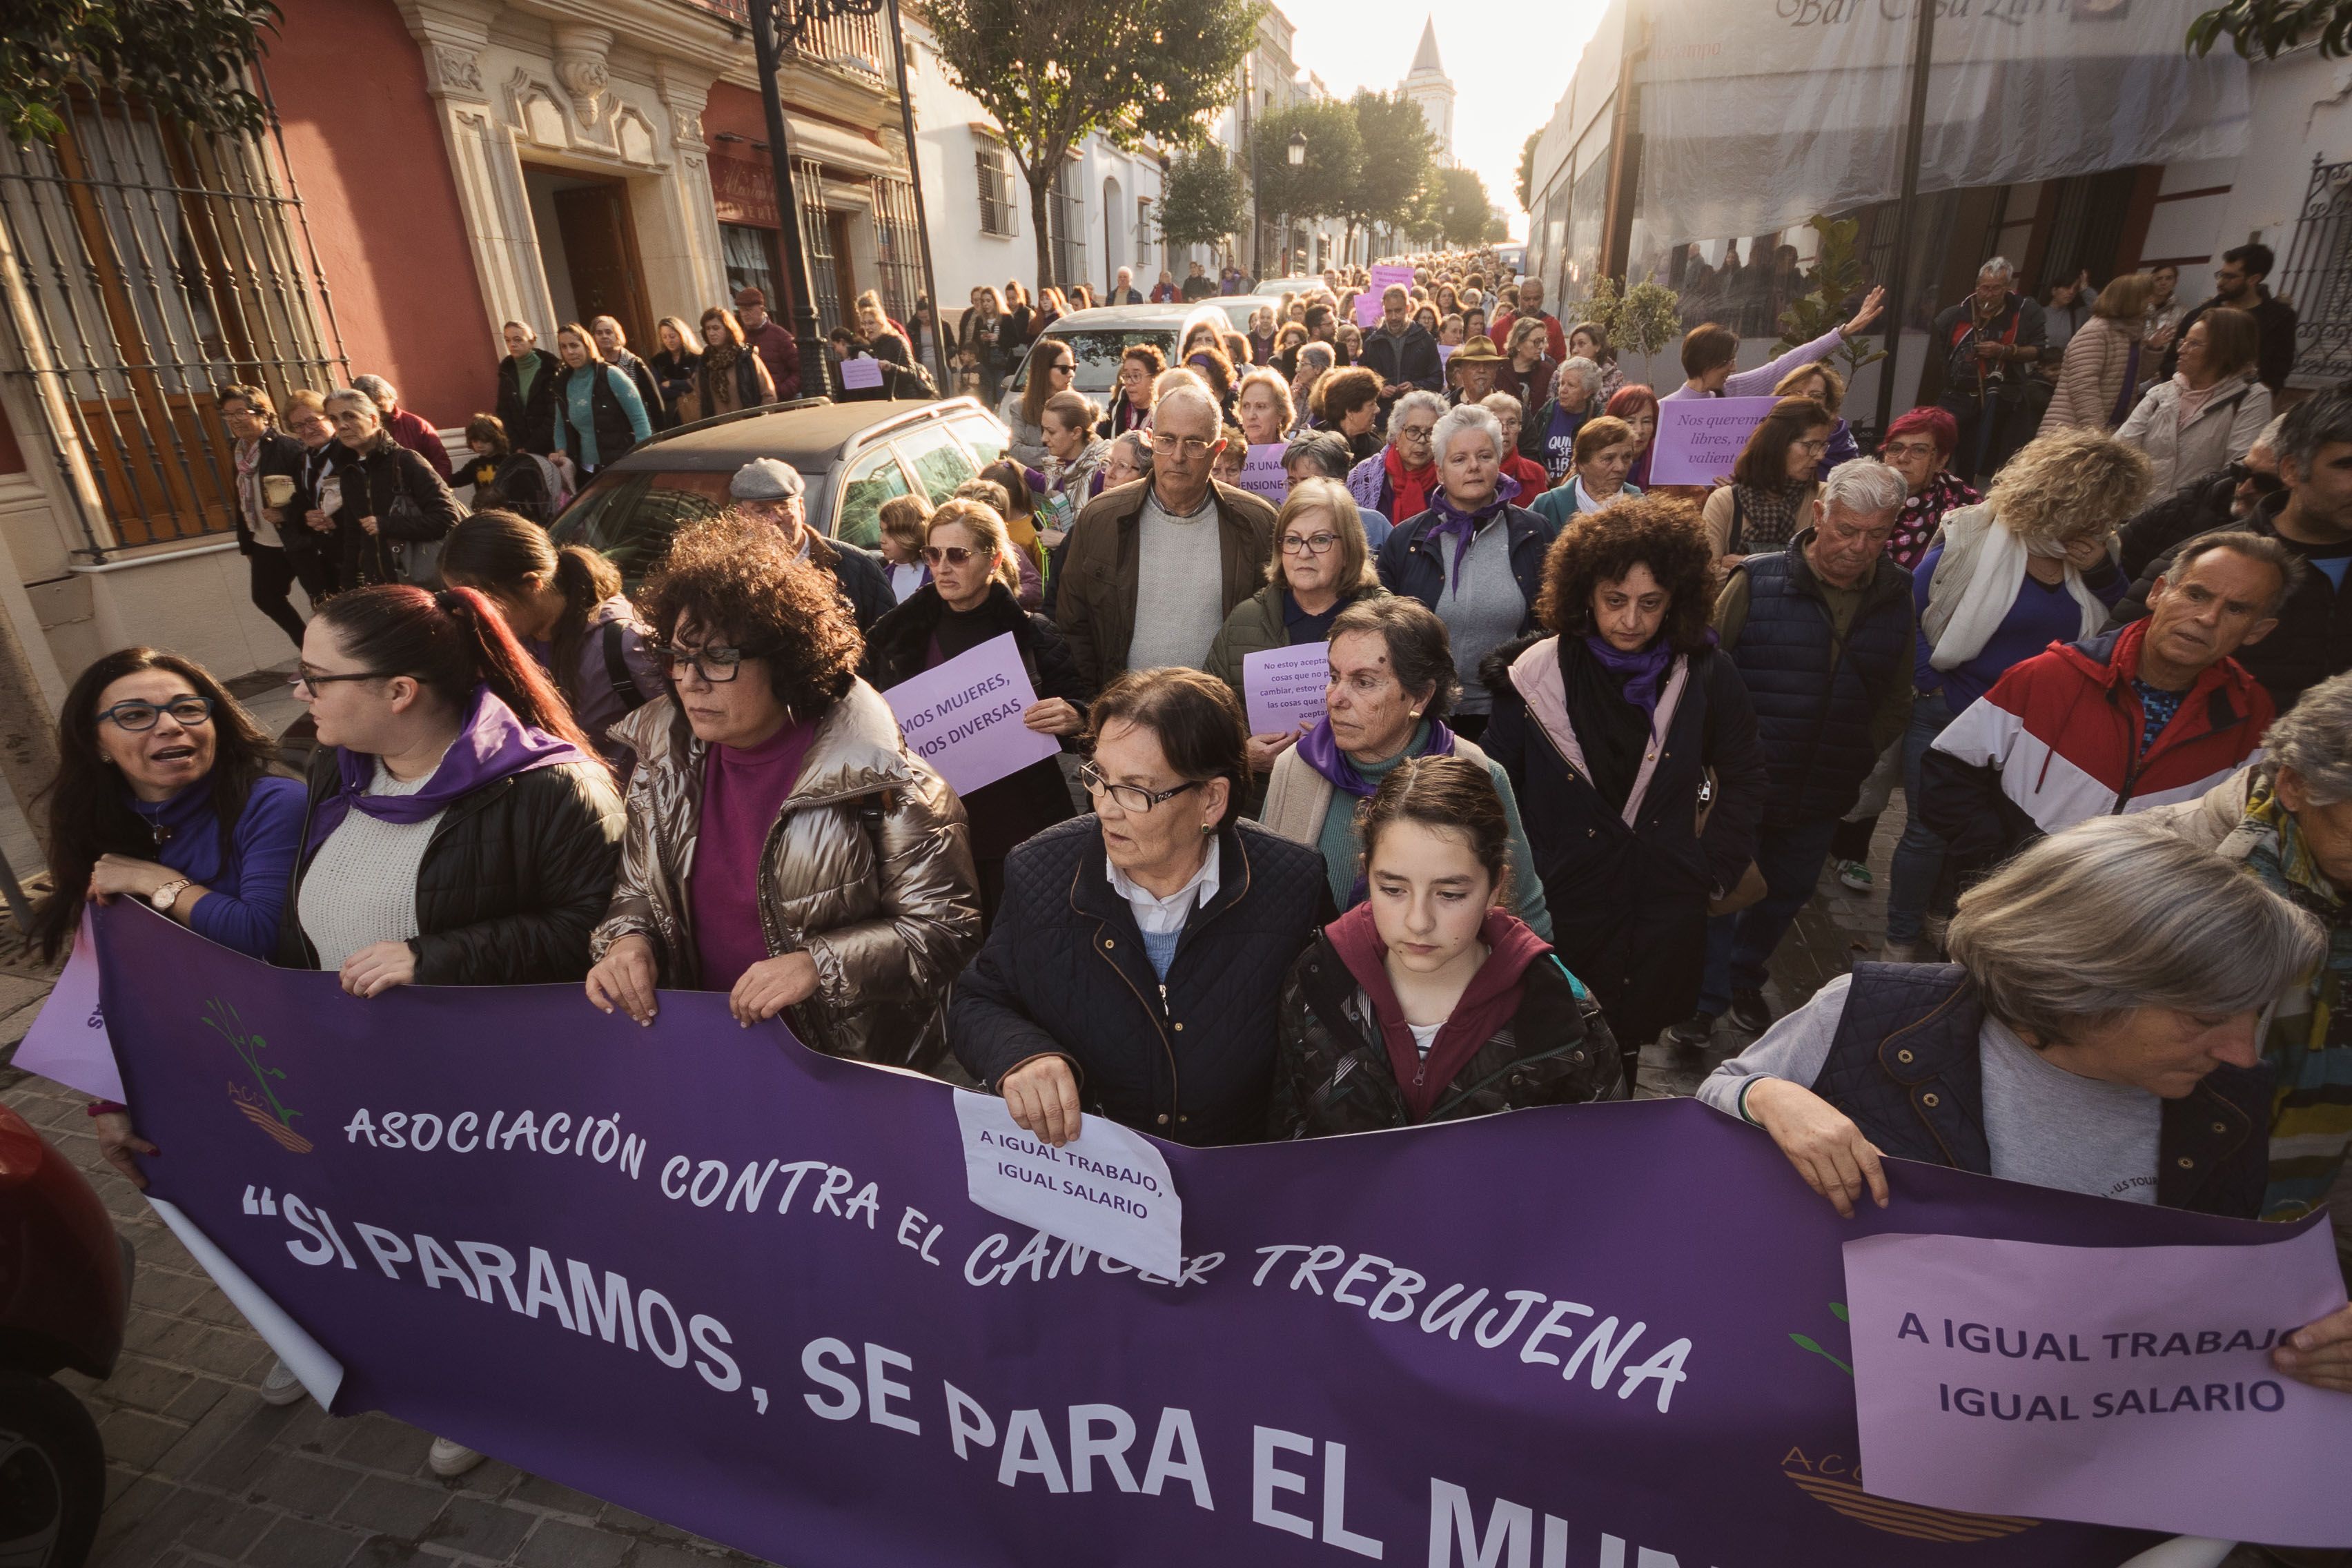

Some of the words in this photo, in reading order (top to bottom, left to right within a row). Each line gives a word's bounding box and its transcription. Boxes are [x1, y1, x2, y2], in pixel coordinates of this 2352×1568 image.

[1677, 414, 1704, 426] Nos
[1691, 432, 1731, 446] libres,
[1689, 451, 1735, 464] valient
[1271, 674, 1293, 682] cosas
[1295, 672, 1309, 681] que
[1277, 660, 1299, 669] estoy
[936, 673, 1010, 717] MUJERES,
[1260, 687, 1294, 697] cambiar,
[1295, 684, 1317, 694] estoy
[1280, 699, 1302, 707] cosas
[1303, 698, 1318, 706] que
[948, 698, 1021, 744] DIVERSAS
[980, 1130, 994, 1146] A
[999, 1134, 1061, 1163] IGUAL
[1065, 1151, 1163, 1198] TRABAJO,
[998, 1162, 1058, 1191] IGUAL
[1063, 1180, 1148, 1219] SALARIO
[344, 1108, 647, 1180] ASOCIACIÓN
[661, 1155, 880, 1230] CONTRA
[897, 1206, 943, 1266] EL
[1253, 1244, 1692, 1413] TREBUJENA
[1897, 1312, 1930, 1344] A
[1943, 1318, 2090, 1362] IGUAL
[353, 1222, 770, 1415] PARAMOS,
[801, 1337, 921, 1436] SE
[944, 1379, 1215, 1511] PARA
[1253, 1424, 1383, 1560] EL
[1939, 1382, 2080, 1422] IGUAL
[2093, 1380, 2285, 1419] SALARIO
